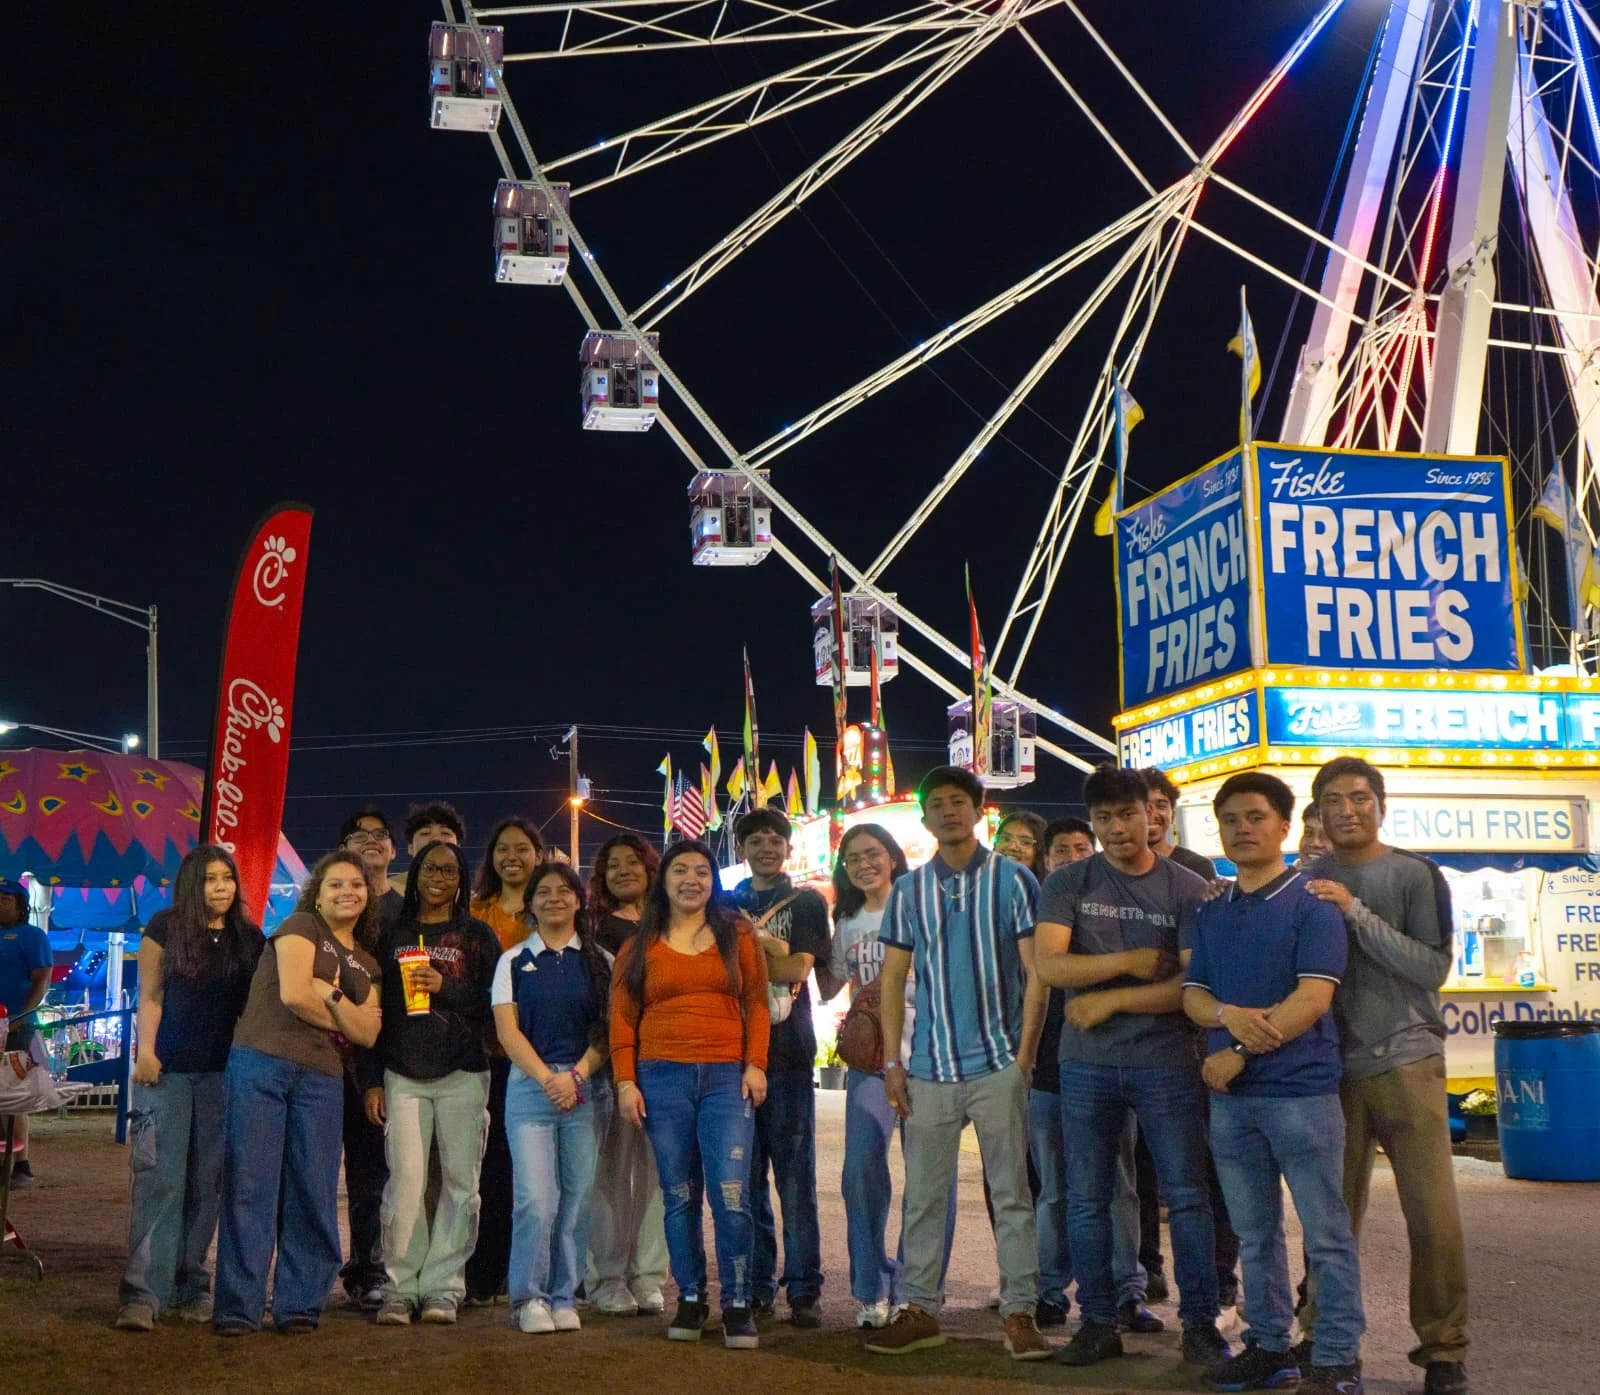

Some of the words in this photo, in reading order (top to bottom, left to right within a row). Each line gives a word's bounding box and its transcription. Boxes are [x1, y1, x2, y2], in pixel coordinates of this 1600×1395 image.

[1204, 479, 1224, 498] Since
[1269, 456, 1345, 498] Fiske
[1425, 468, 1462, 485] Since
[1126, 503, 1166, 560] Fiske
[1269, 500, 1501, 583] FRENCH
[1126, 507, 1247, 627] FRENCH
[1146, 598, 1237, 694] FRIES
[1304, 584, 1474, 662] FRIES
[1120, 718, 1187, 770] FRENCH
[1191, 698, 1251, 755] FRIES
[1288, 700, 1362, 735] Fiske
[1374, 696, 1559, 742] FRENCH
[1382, 808, 1475, 839] ENCH
[1485, 809, 1572, 840] FRIES
[1562, 874, 1595, 883] SINCE
[1441, 1001, 1505, 1035] Cold
